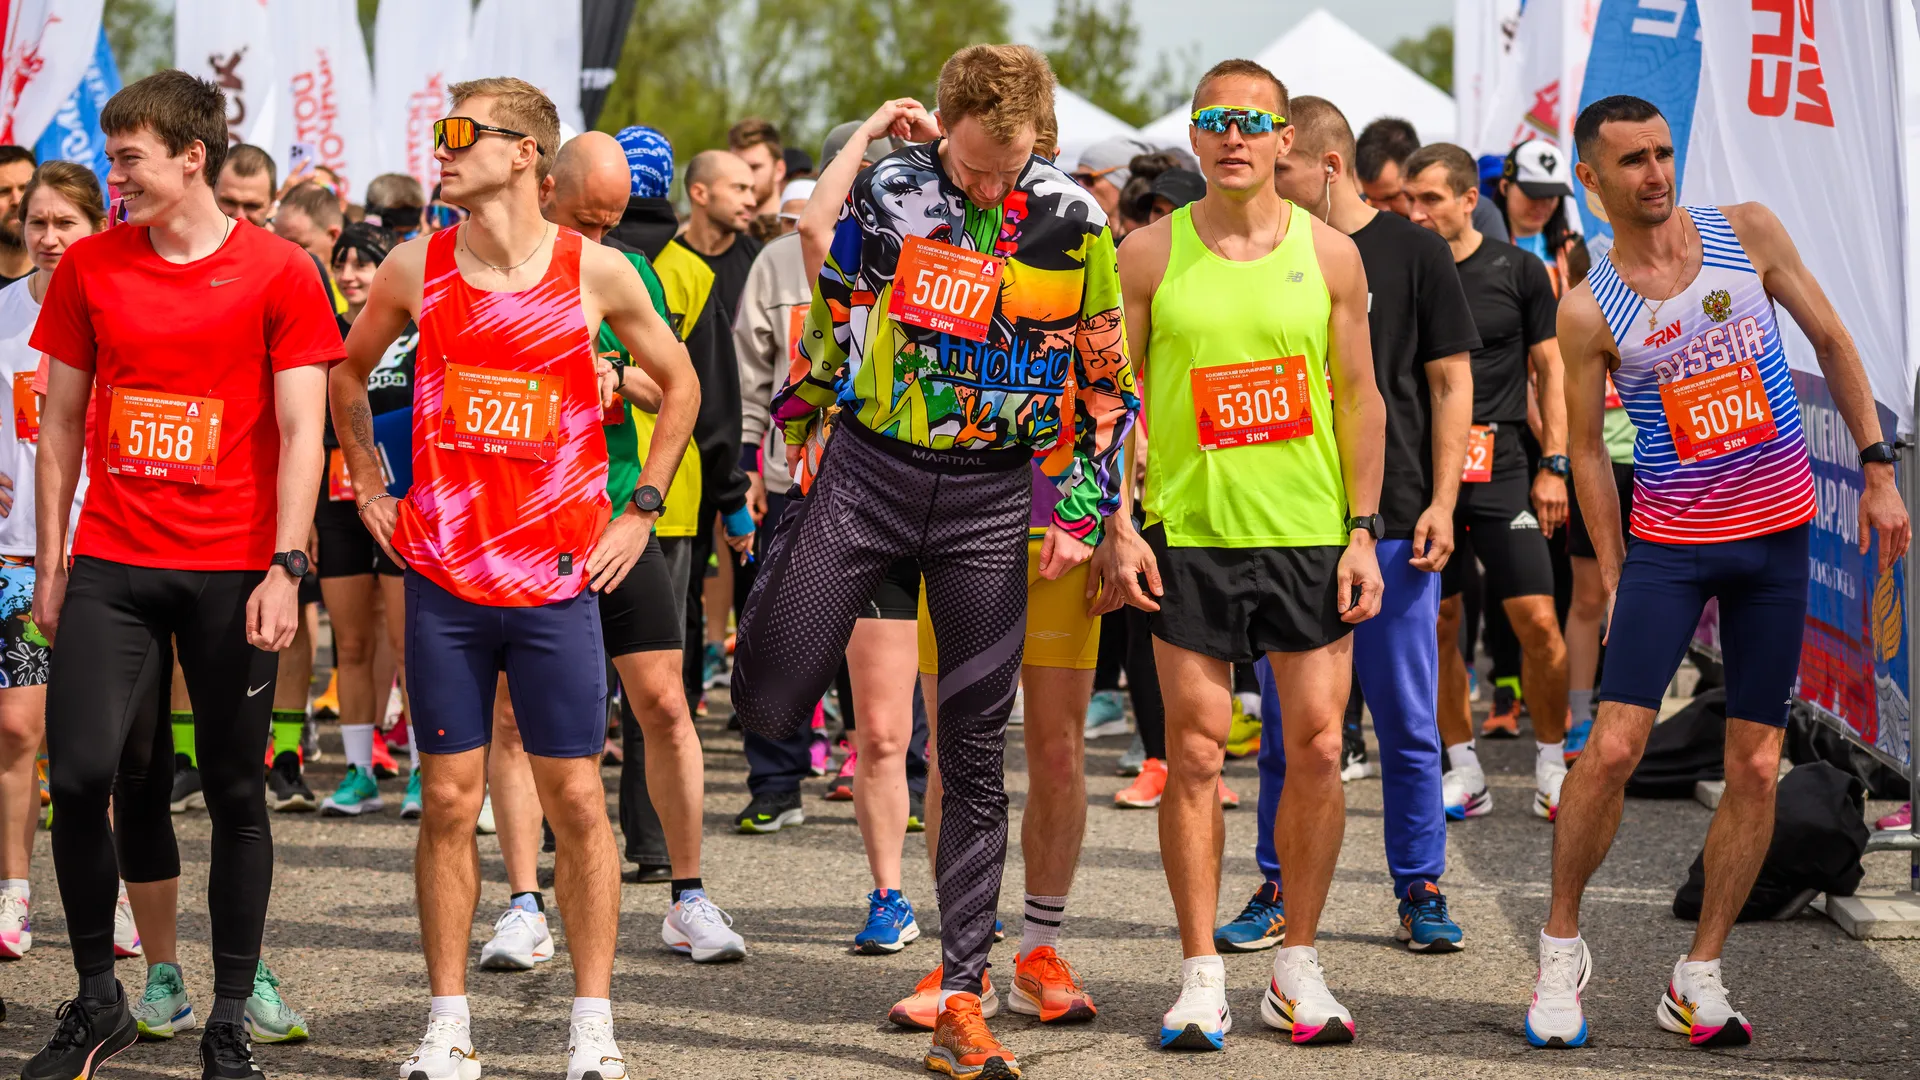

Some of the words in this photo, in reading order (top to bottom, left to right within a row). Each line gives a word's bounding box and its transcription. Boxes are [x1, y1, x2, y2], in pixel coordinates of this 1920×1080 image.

[982, 261, 994, 275] A
[912, 269, 990, 318] 5007
[1276, 365, 1283, 373] B
[1740, 367, 1753, 380] A
[368, 371, 407, 391] ppa
[529, 381, 537, 390] B
[187, 402, 199, 415] A
[1217, 386, 1290, 428] 5303
[1689, 390, 1764, 440] 5094
[466, 396, 533, 438] 5241
[128, 419, 193, 461] 5158
[912, 450, 987, 466] MARTIAL
